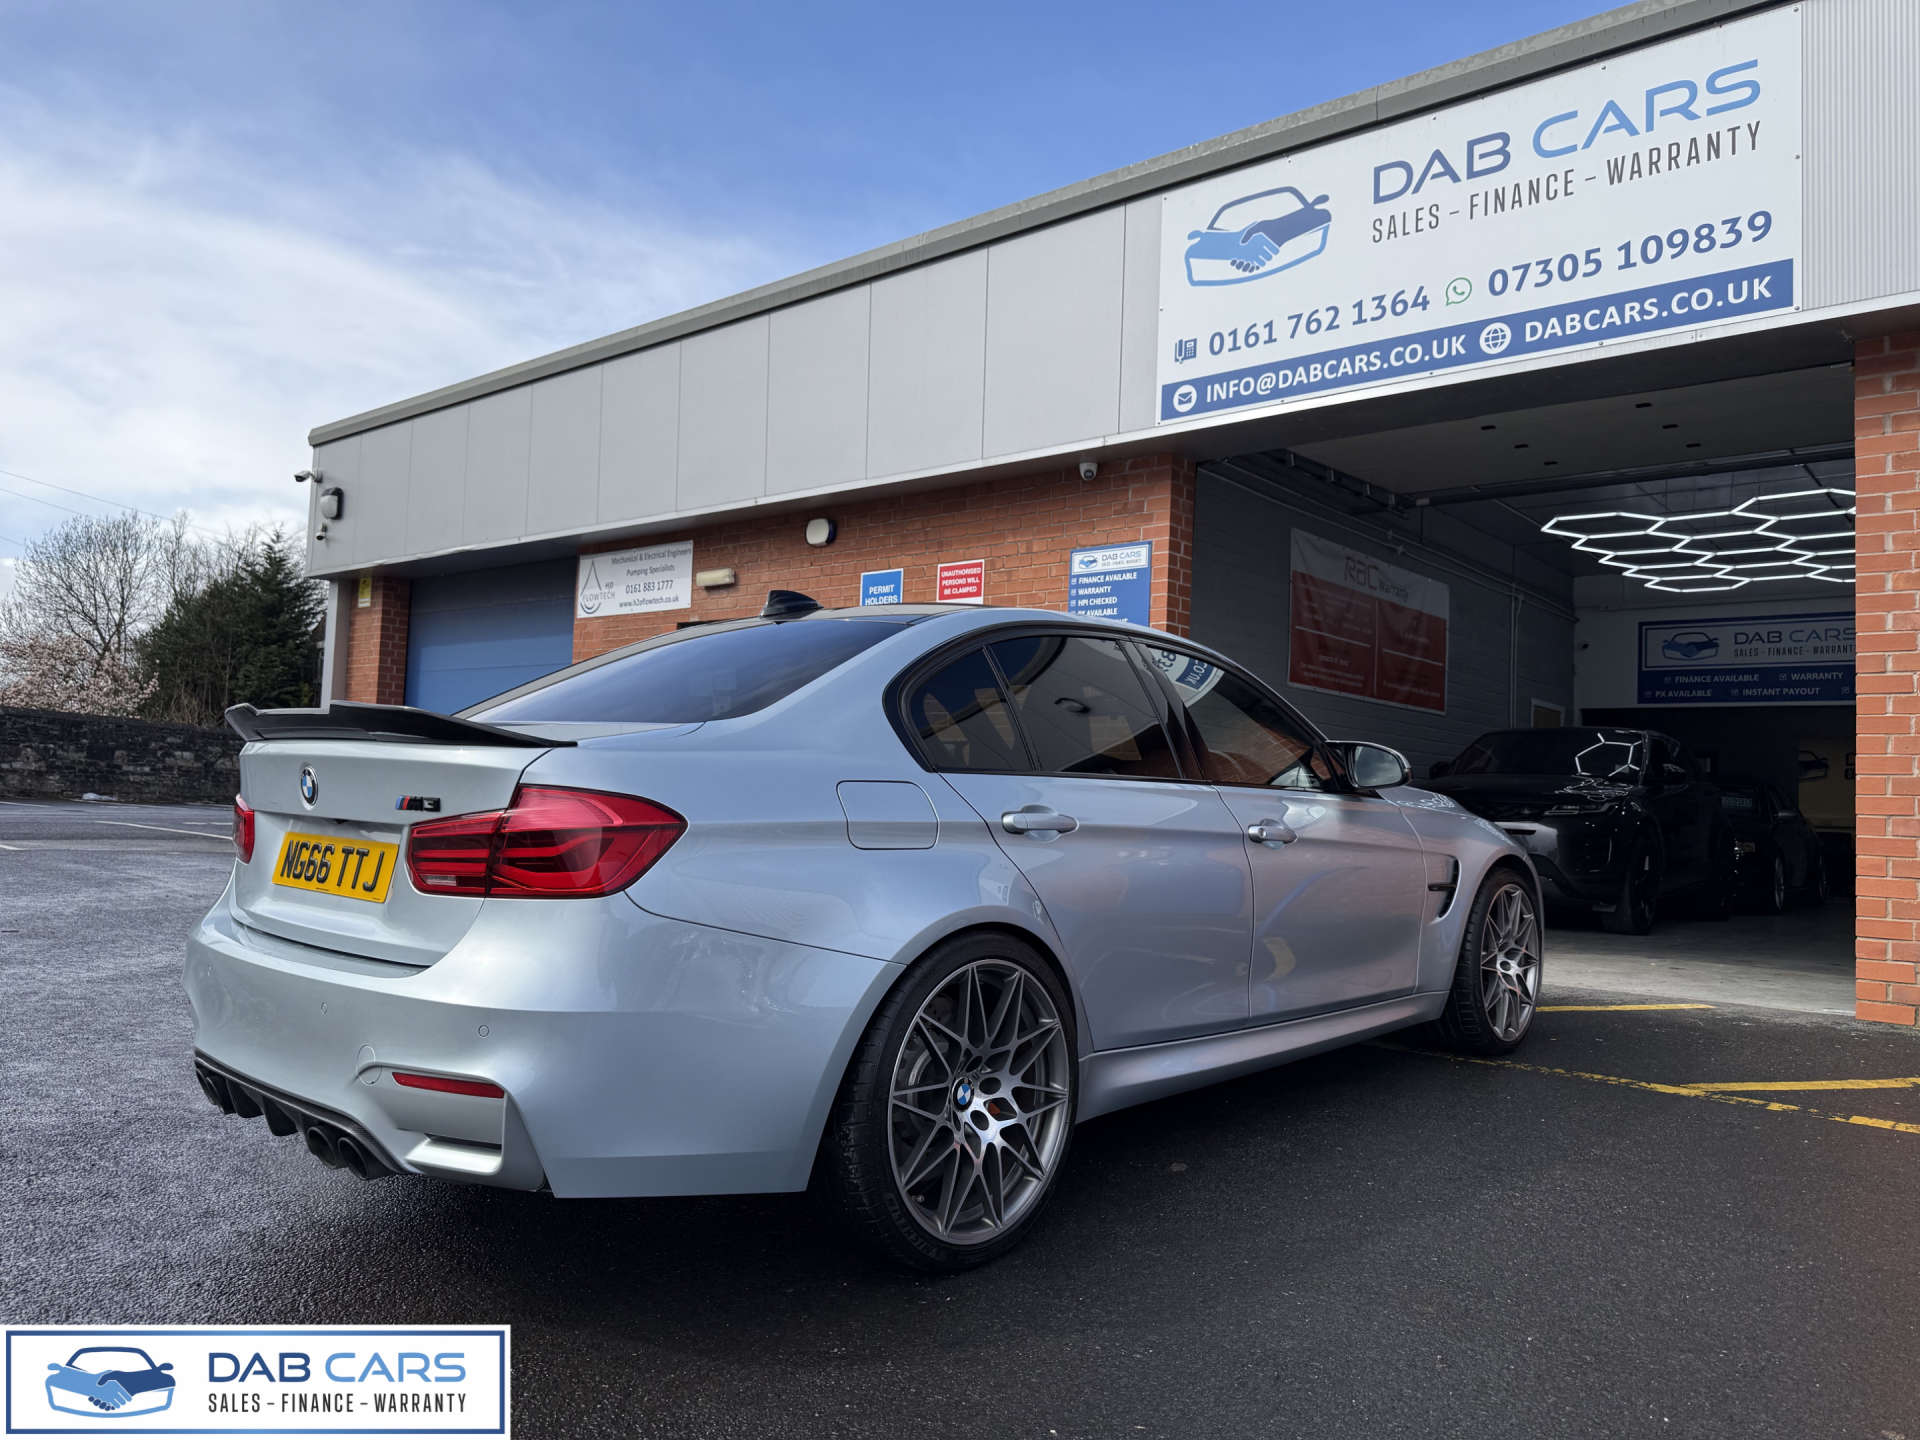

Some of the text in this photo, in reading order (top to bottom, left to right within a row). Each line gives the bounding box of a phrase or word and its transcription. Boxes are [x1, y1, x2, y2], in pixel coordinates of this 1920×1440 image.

[1373, 58, 1761, 205] DAB CARS
[1372, 203, 1440, 244] SALES
[1469, 168, 1575, 221] FINANCE
[1606, 120, 1761, 187] WARRANTY
[1208, 210, 1773, 356] 0161 762 1364 07305 109839
[1206, 275, 1773, 403] INFO@DABCARS.CO.UK DABCARS.CO.UK
[1102, 553, 1118, 562] DAB
[941, 567, 982, 577] UNAUTHORISED
[942, 578, 966, 586] PERSONS
[1078, 572, 1137, 584] FINANCE AVAILABLE
[626, 580, 674, 594] 0161 883 1777
[869, 584, 895, 594] PERMIT
[952, 586, 978, 594] CLAMPED
[1078, 586, 1112, 596] WARRANTY
[865, 595, 898, 606] HOLDERS
[1090, 596, 1118, 606] CHECKED
[1734, 628, 1855, 644] DAB CARS
[1675, 672, 1844, 684] FINANCE AVAILABLE WARRANTY
[1668, 688, 1712, 698] AVAILABLE
[1743, 688, 1782, 696] INSTANT
[1783, 687, 1821, 696] PAYOUT
[280, 839, 385, 892] NG66 TTJ
